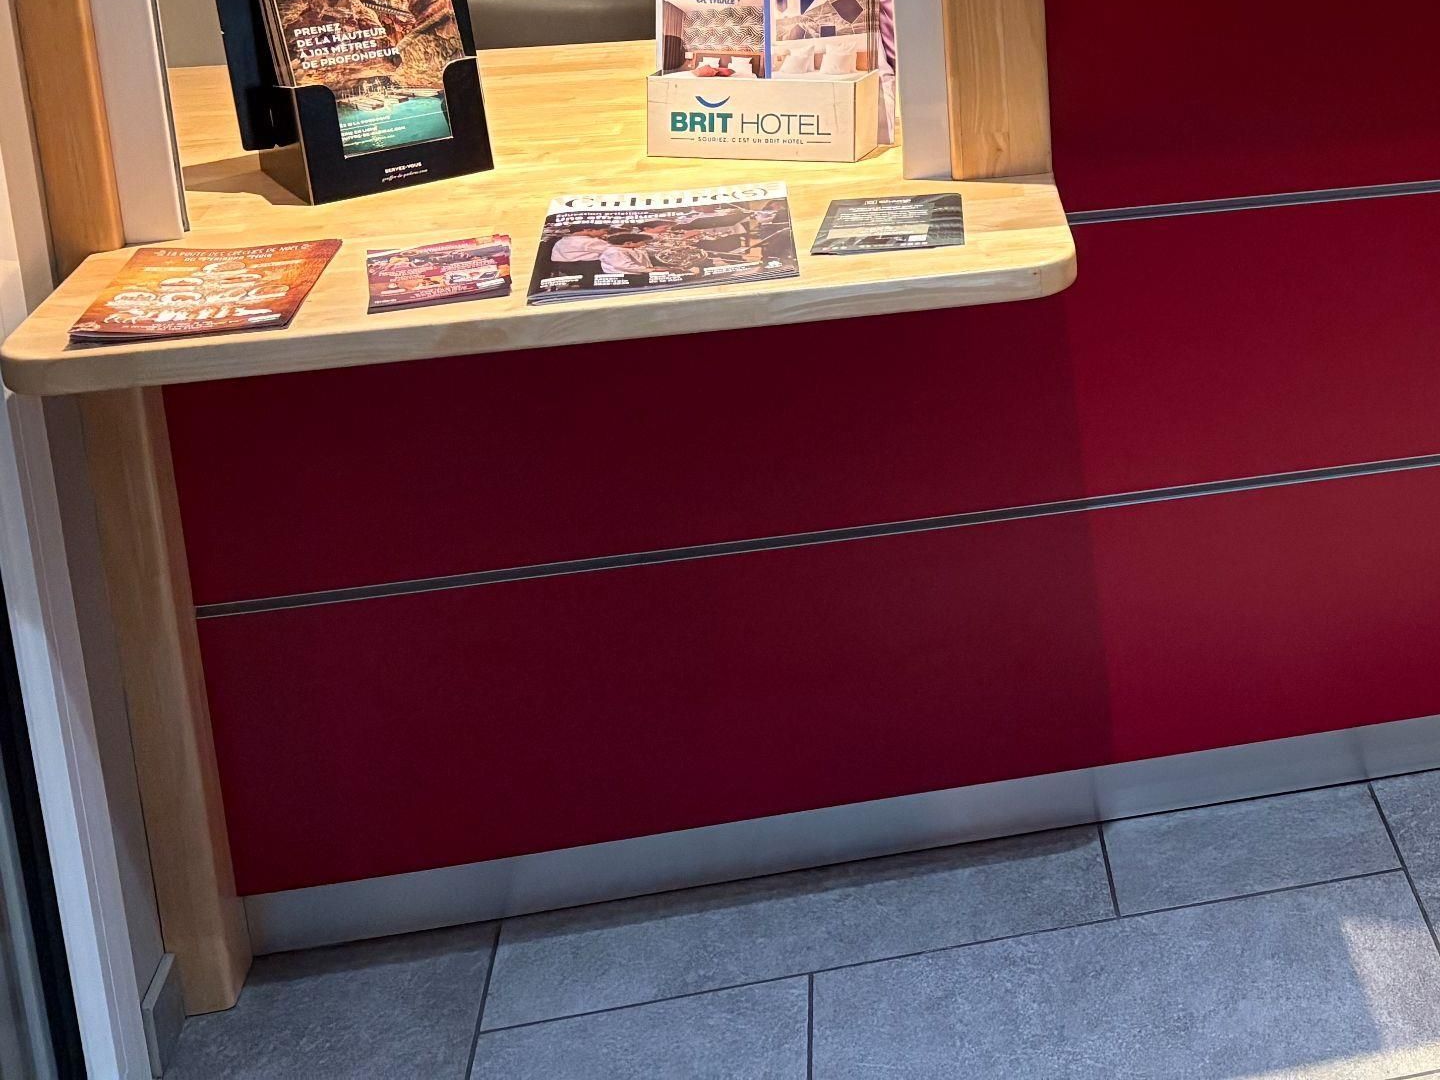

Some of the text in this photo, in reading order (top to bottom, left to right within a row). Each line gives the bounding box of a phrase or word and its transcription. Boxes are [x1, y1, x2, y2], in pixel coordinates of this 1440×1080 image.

[293, 22, 342, 37] PRENEZ
[296, 27, 387, 48] DE LA HAUTEUR
[302, 47, 401, 70] DE PROFONDEUR
[671, 111, 832, 136] BRIT HOTEL
